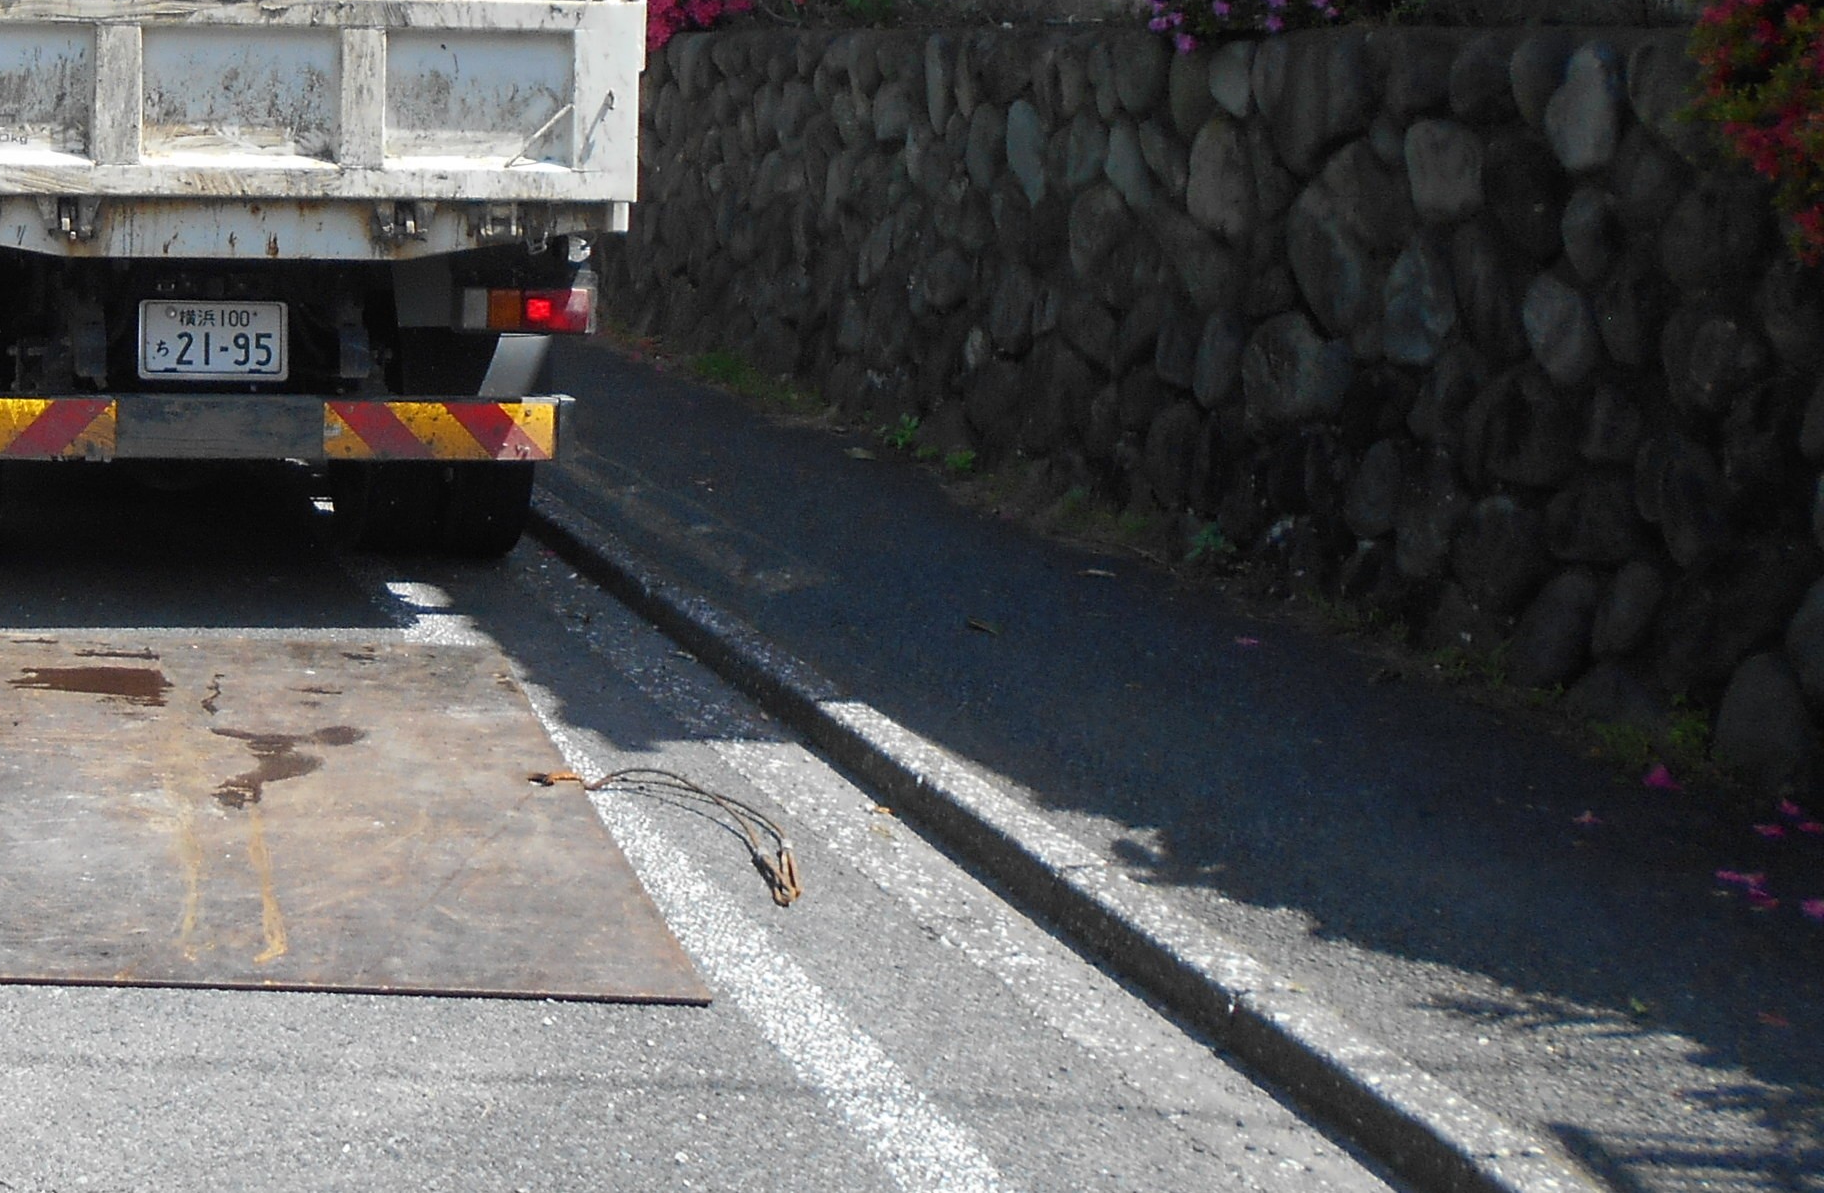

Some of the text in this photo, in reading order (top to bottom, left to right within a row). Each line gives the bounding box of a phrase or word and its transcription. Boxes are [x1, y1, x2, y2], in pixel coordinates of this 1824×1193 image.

[179, 309, 251, 327] 横浜100
[156, 332, 272, 367] ち 21-95
